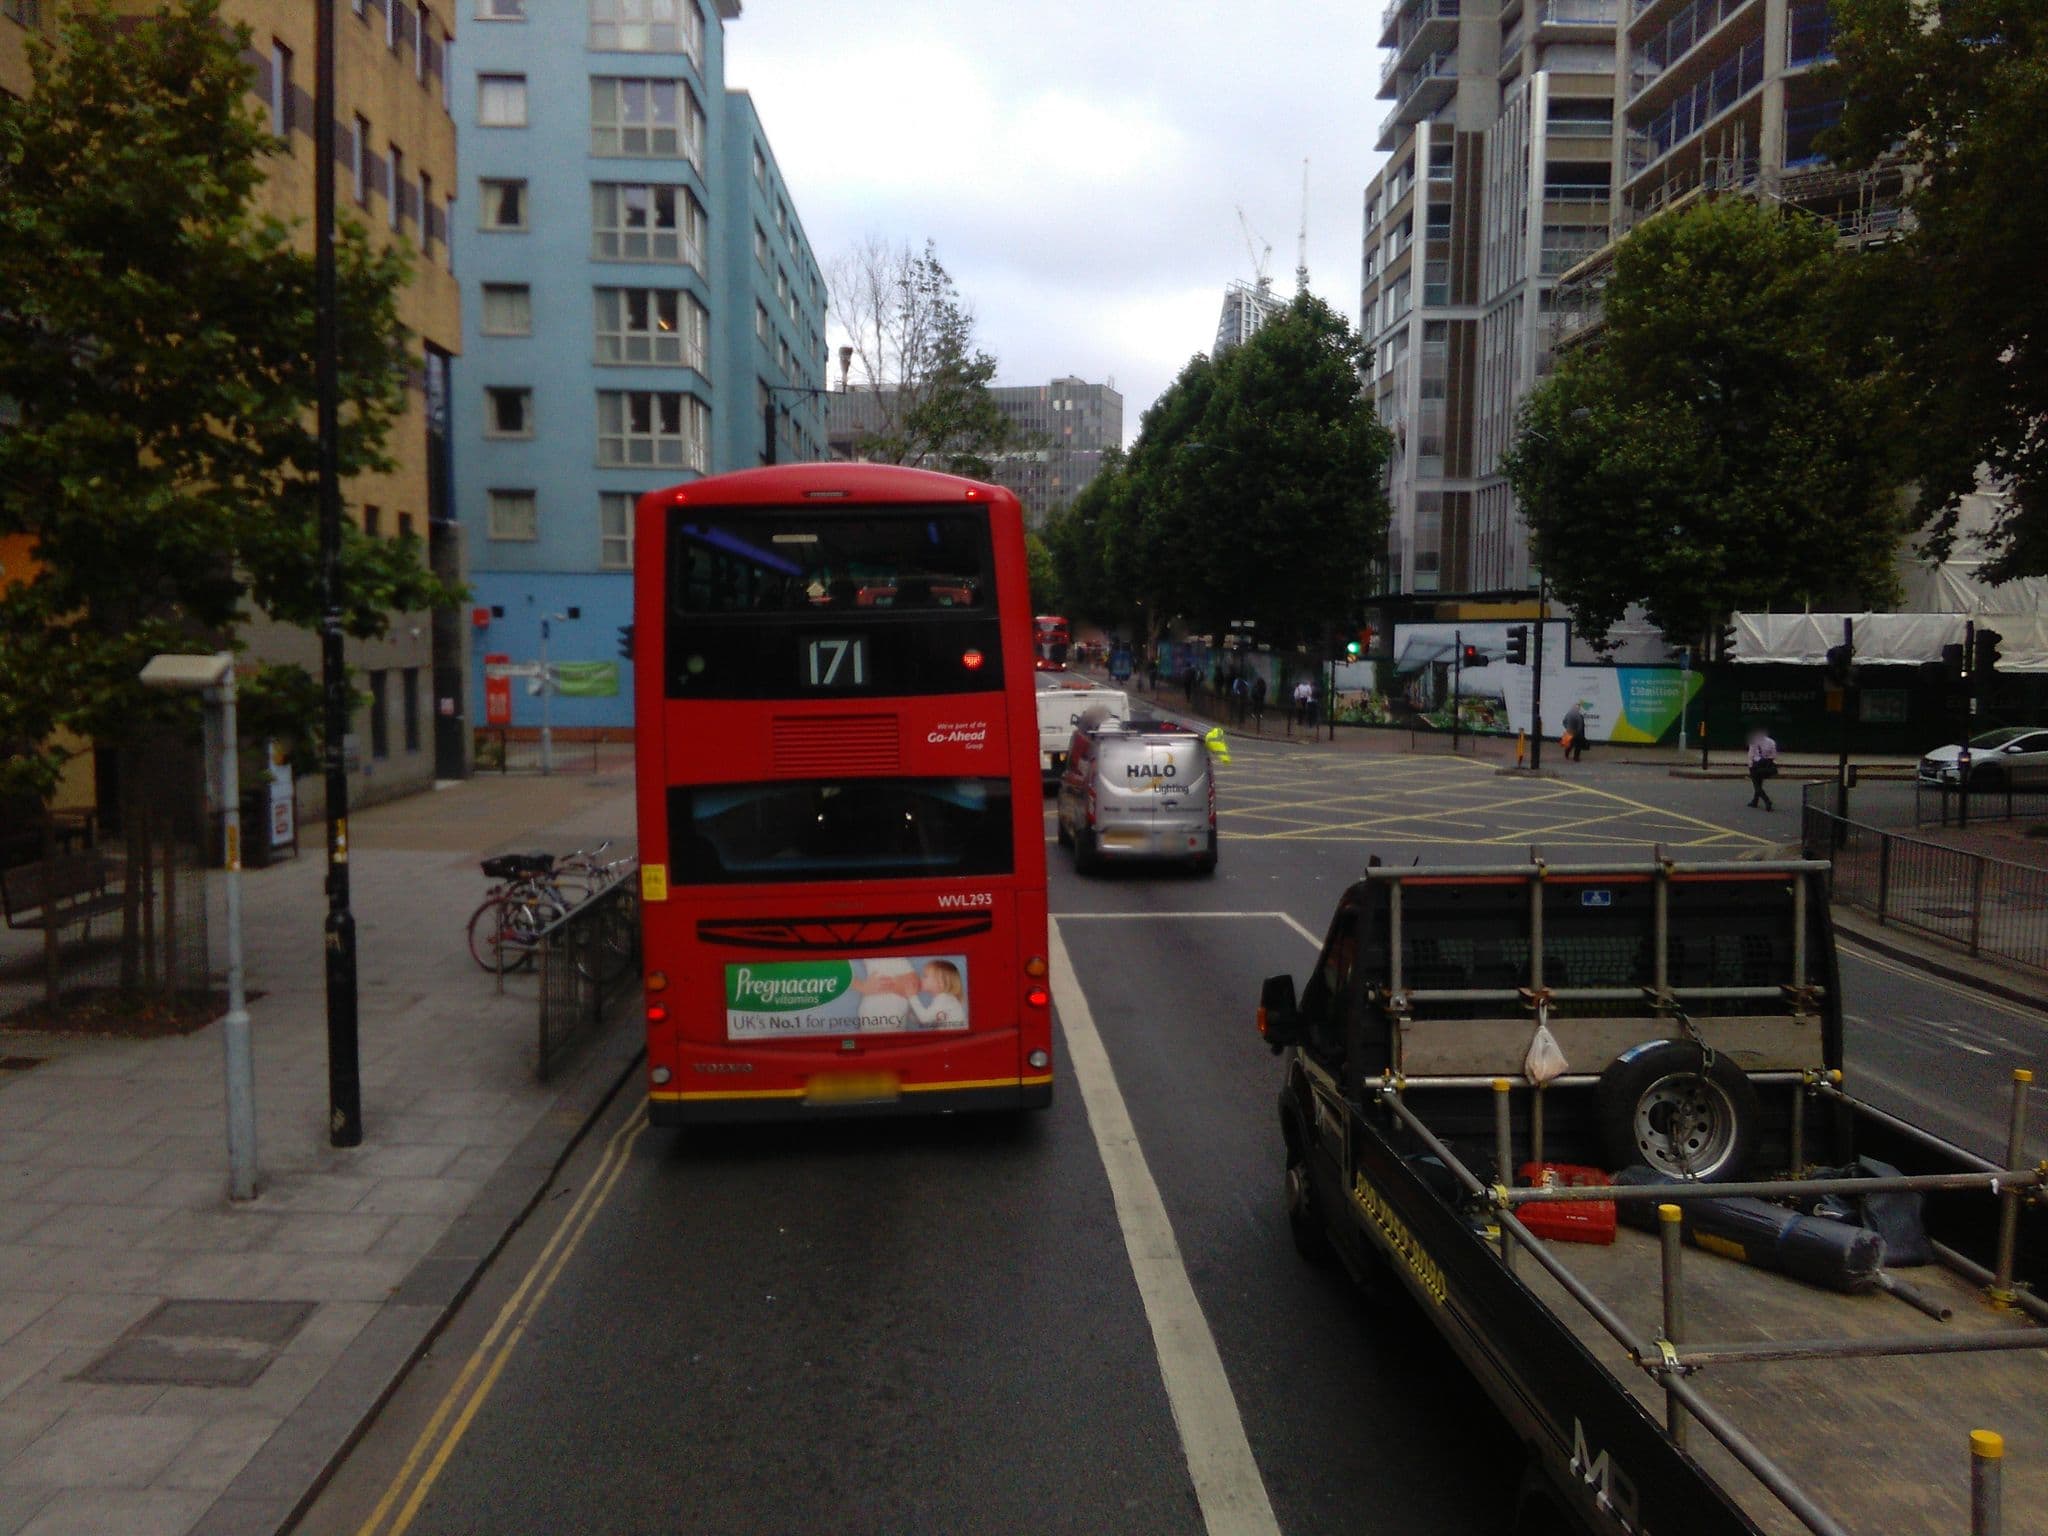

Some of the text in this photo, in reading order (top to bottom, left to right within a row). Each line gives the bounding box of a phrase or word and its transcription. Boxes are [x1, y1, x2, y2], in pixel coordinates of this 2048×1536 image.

[809, 640, 862, 684] 171
[977, 720, 986, 728] the
[927, 730, 985, 743] Go-Ahead
[965, 742, 984, 750] Group
[1127, 764, 1176, 777] HALO
[1154, 783, 1189, 795] Lighting
[938, 893, 992, 907] WVL293
[736, 968, 838, 1003] Pregnacare
[774, 994, 819, 1004] vitamins
[733, 1014, 766, 1030] UK's
[769, 1014, 801, 1029] No.1
[806, 1014, 829, 1028] for
[829, 1013, 905, 1030] pregnancy
